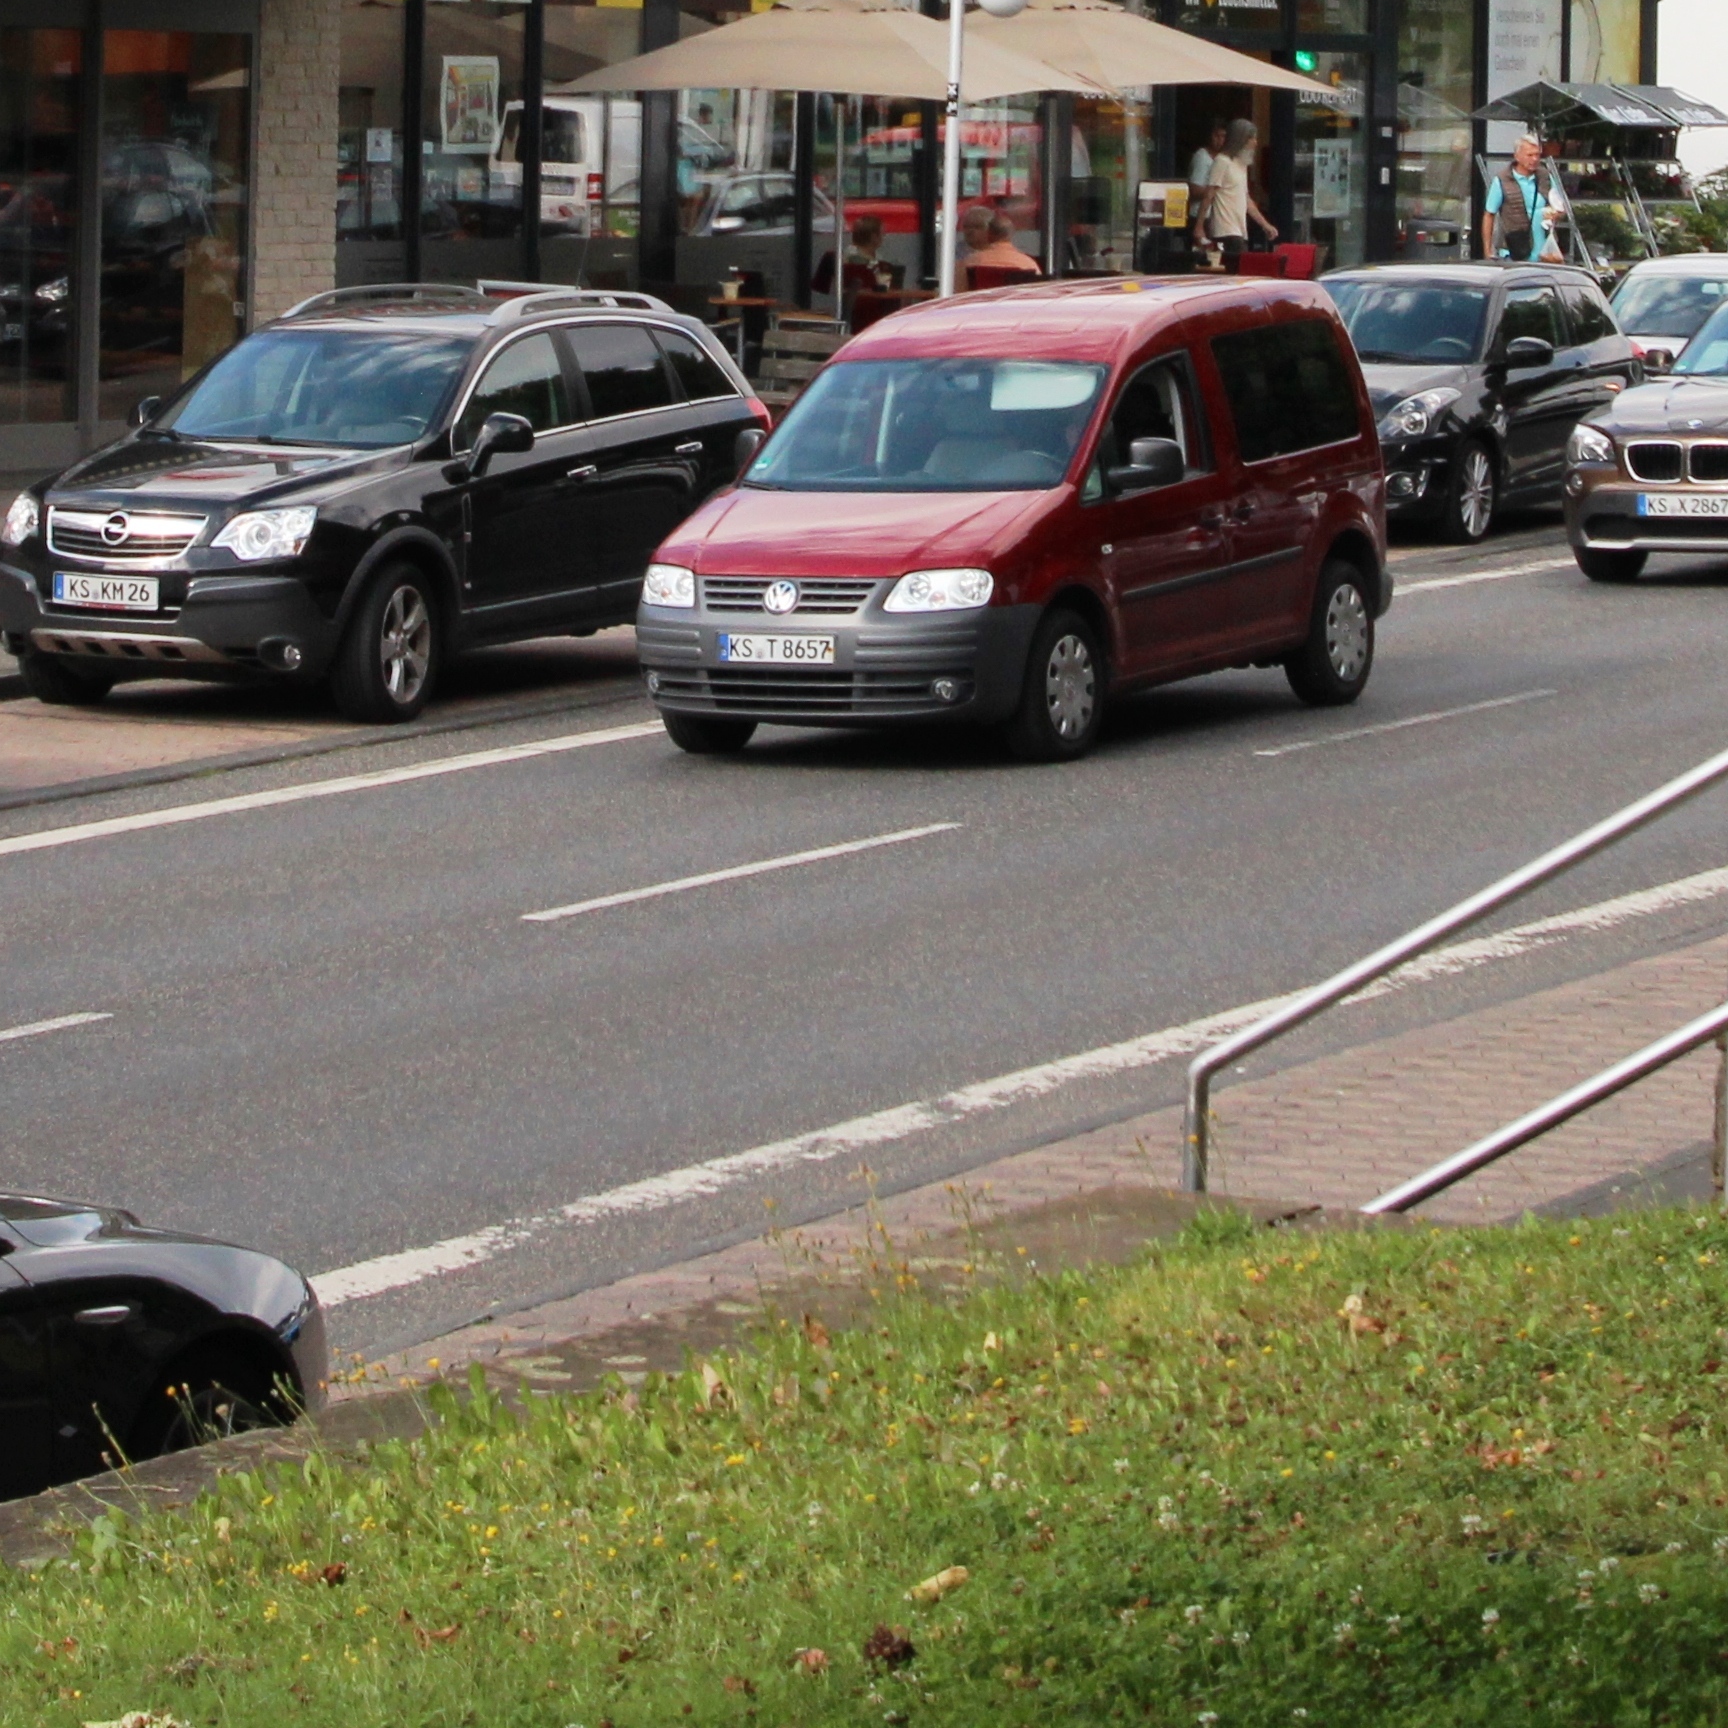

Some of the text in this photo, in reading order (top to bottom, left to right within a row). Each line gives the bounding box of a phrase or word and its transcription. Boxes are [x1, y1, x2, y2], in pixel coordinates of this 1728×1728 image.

[1647, 498, 1668, 514] KS
[69, 578, 150, 602] KS KM 26
[729, 638, 753, 658] KS
[782, 638, 831, 659] 8657
